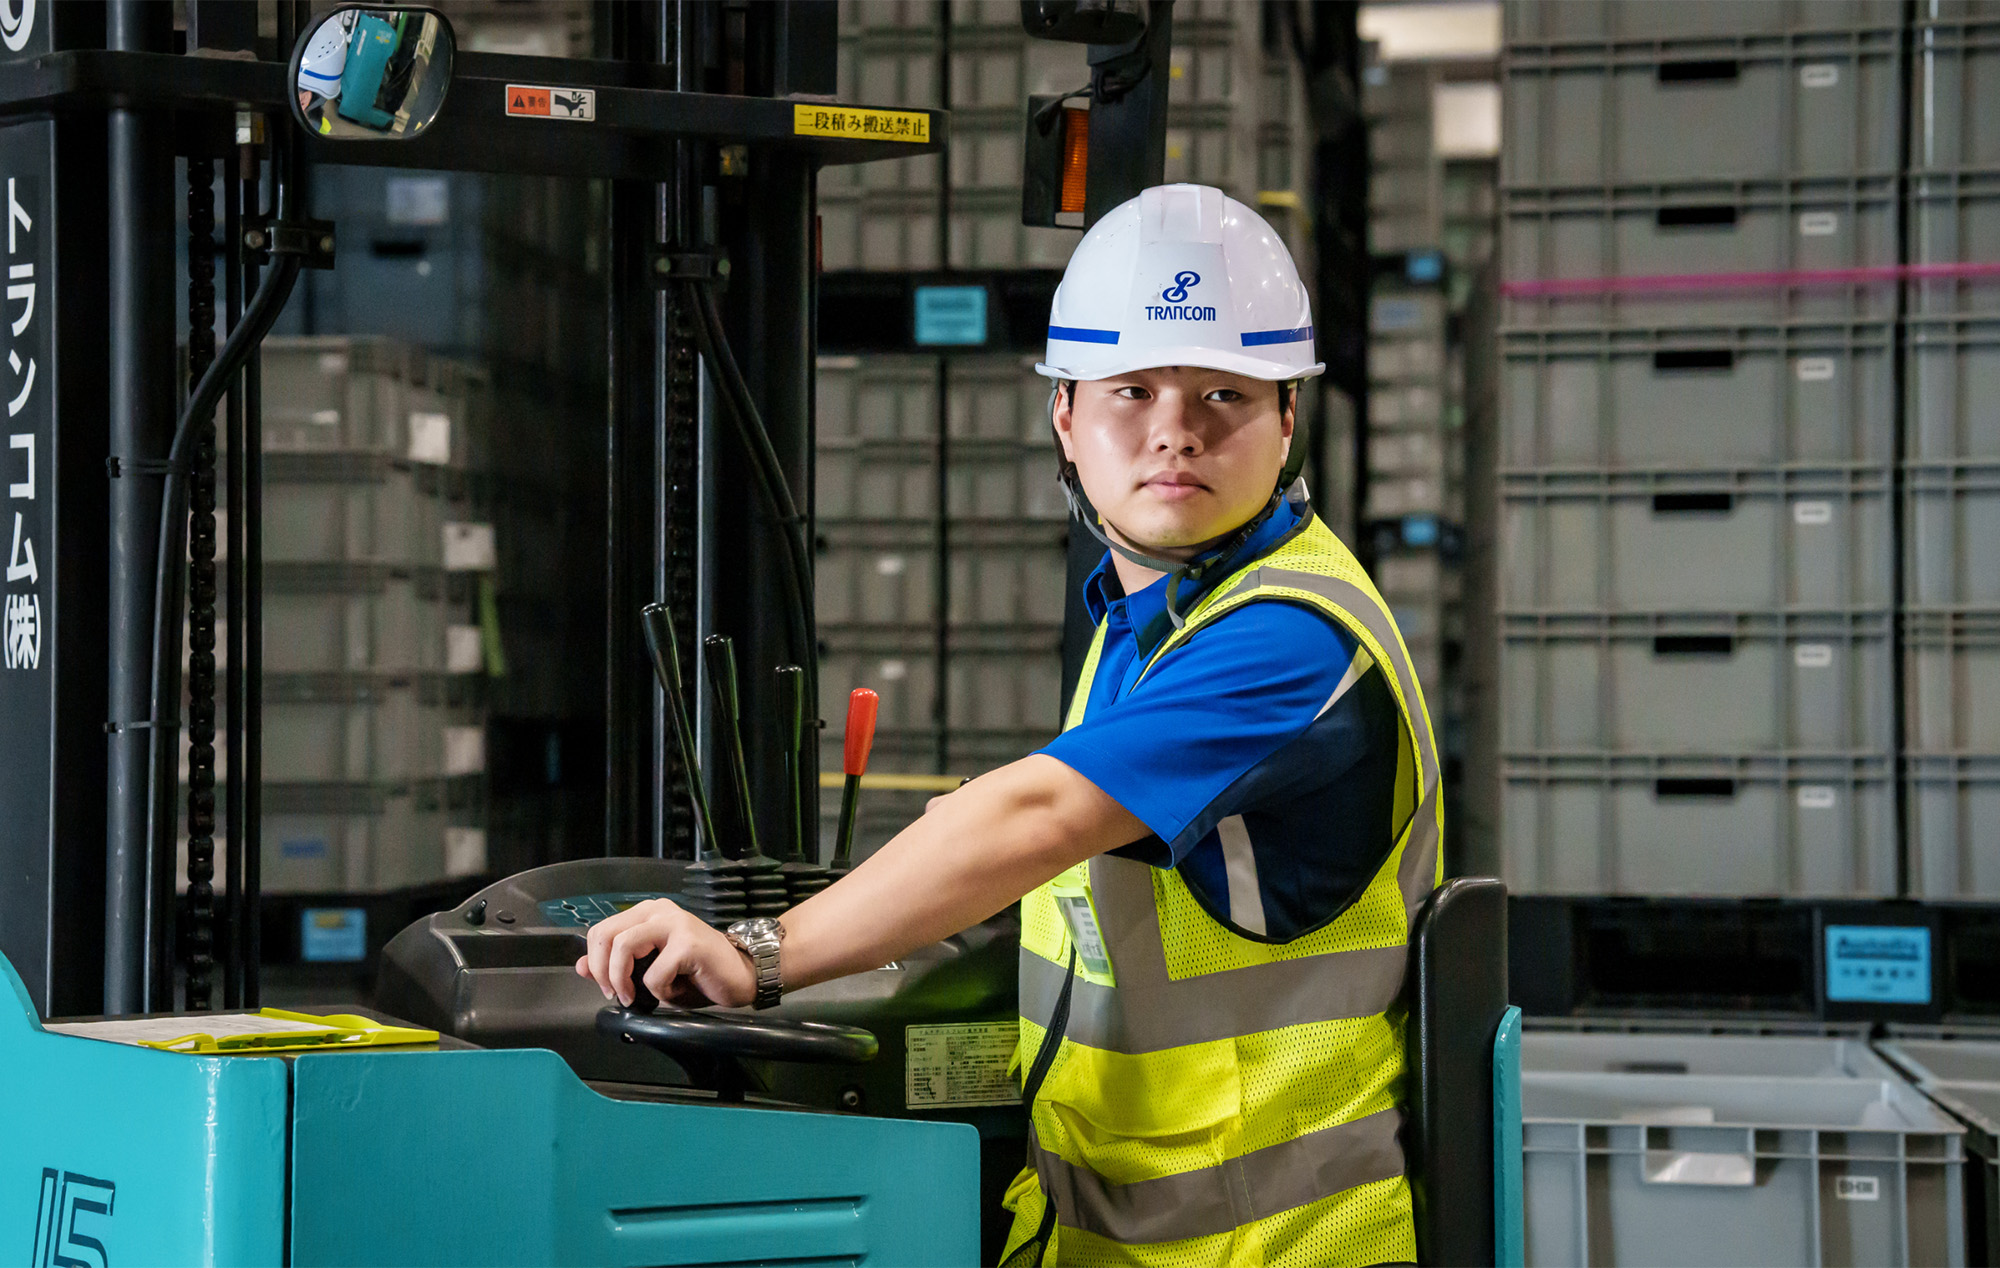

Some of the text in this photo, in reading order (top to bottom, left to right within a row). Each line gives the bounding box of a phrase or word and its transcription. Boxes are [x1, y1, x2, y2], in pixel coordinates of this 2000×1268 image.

[798, 111, 927, 137] 二段積み搬送禁止
[1145, 306, 1216, 321] TRANCOM
